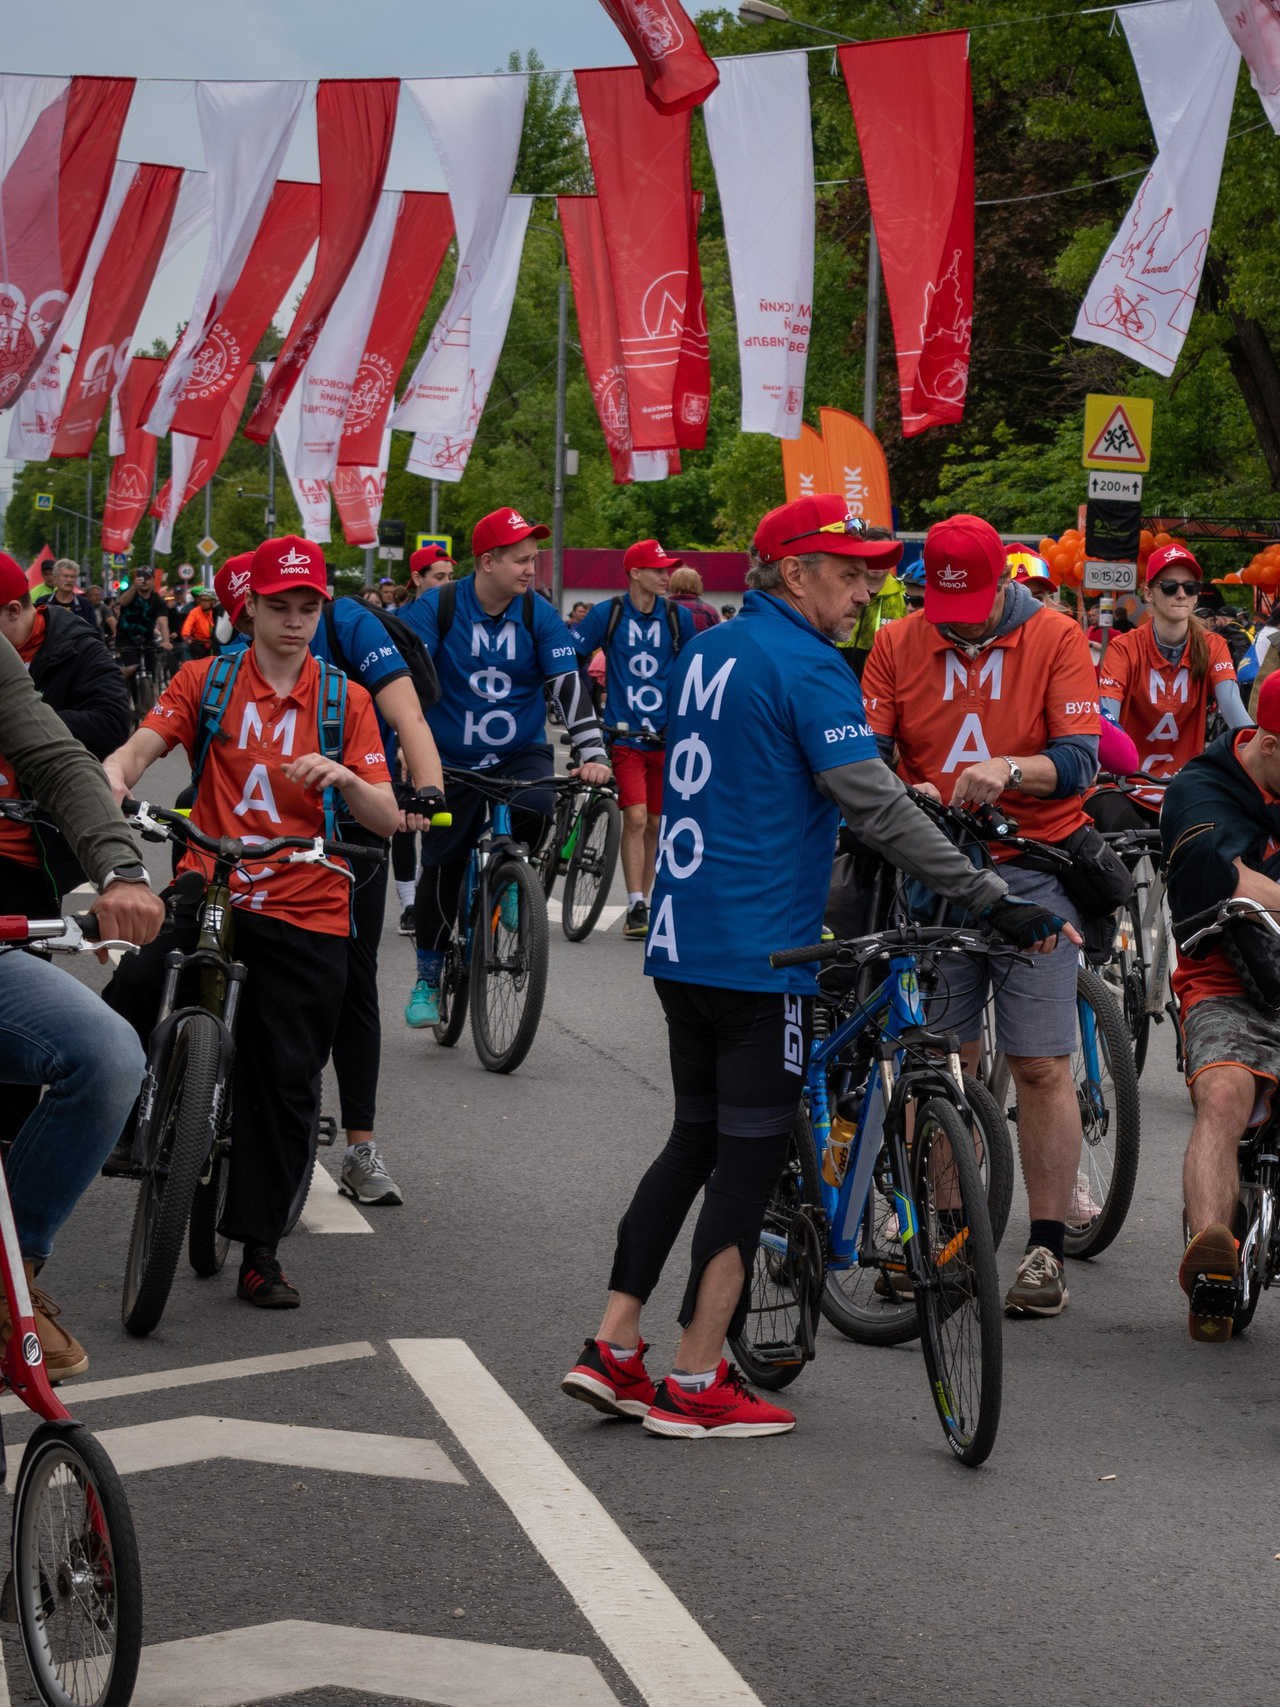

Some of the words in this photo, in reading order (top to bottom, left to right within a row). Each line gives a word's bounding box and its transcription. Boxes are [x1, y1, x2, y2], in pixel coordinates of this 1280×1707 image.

[280, 566, 311, 575] МФЮА
[1091, 571, 1100, 581] 10
[1101, 571, 1112, 583] 15
[1115, 570, 1131, 584] 20
[232, 583, 250, 599] МФЮ
[939, 580, 968, 589] МФЮА
[552, 646, 571, 658] ВУЗ
[1214, 661, 1234, 672] ВУЗ
[1065, 701, 1092, 715] ВУЗ
[824, 723, 858, 744] ВУЗ
[858, 723, 874, 737] №
[364, 752, 386, 766] ВУЗ
[948, 1433, 965, 1456] KENDA
